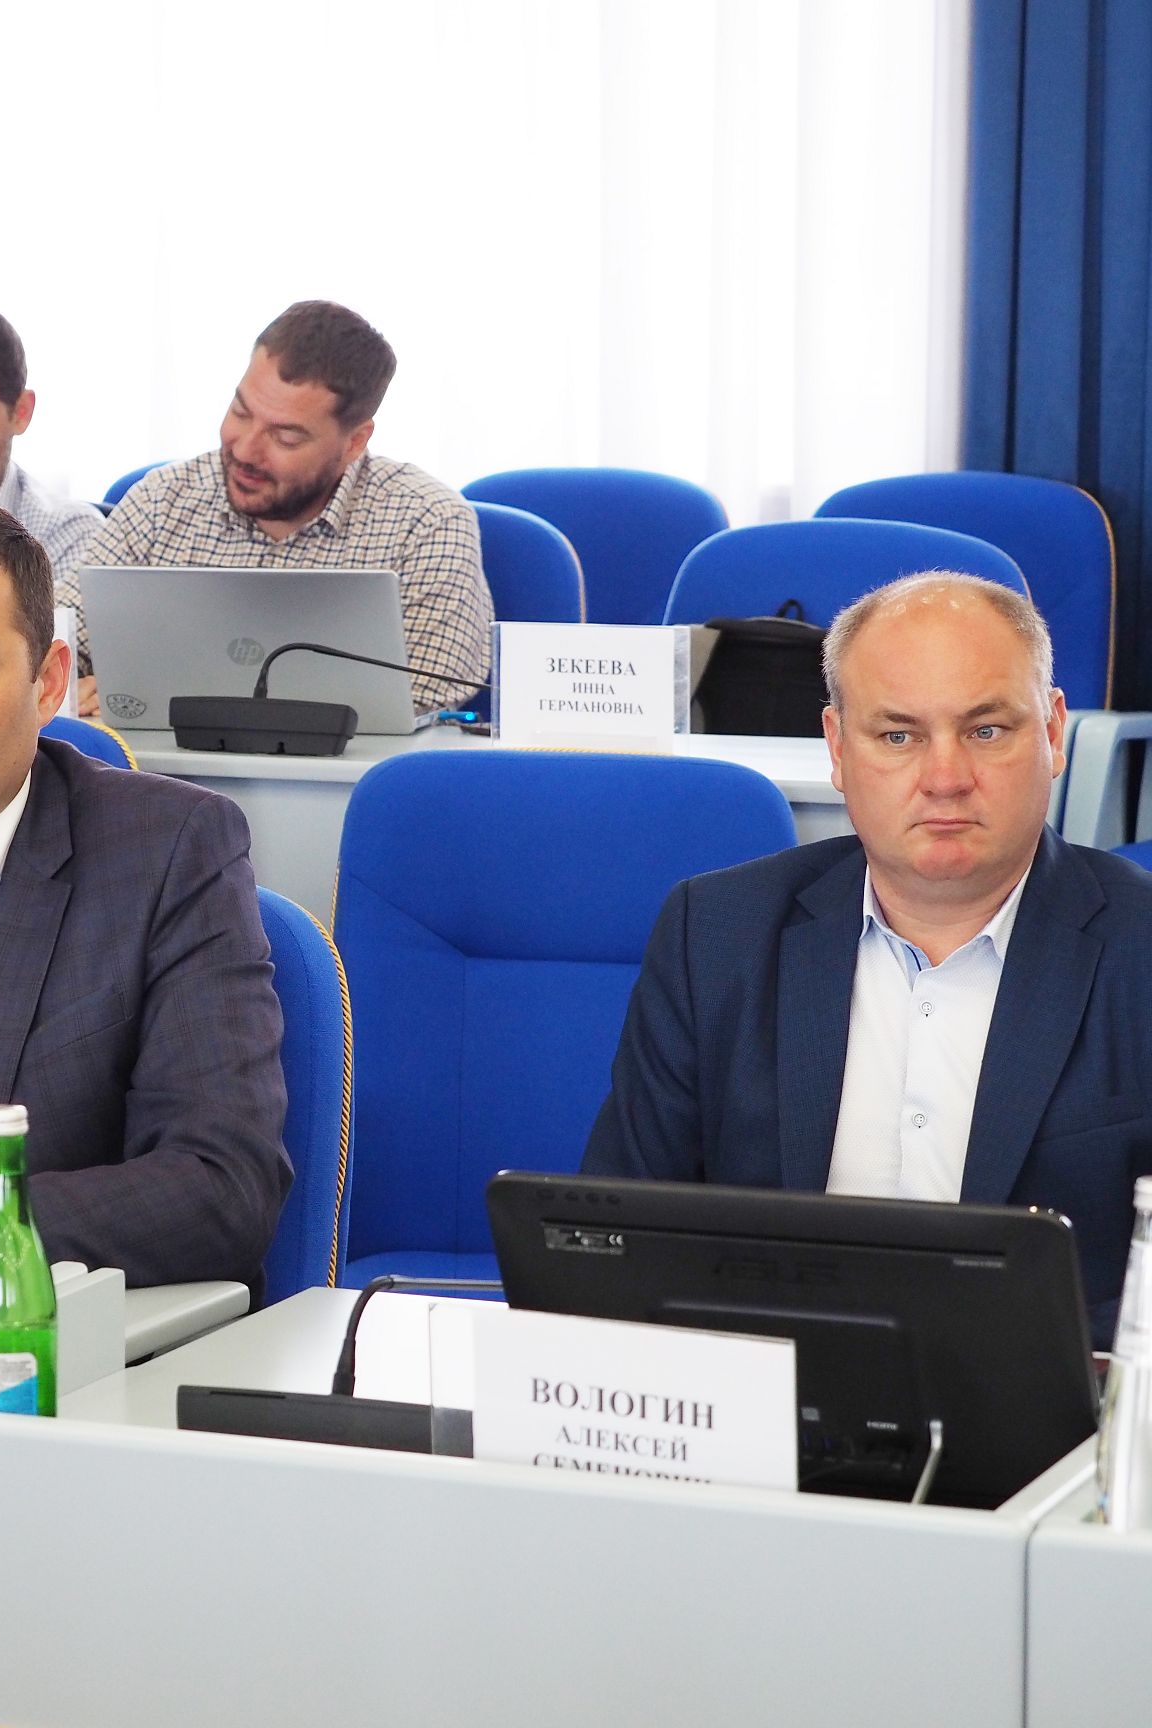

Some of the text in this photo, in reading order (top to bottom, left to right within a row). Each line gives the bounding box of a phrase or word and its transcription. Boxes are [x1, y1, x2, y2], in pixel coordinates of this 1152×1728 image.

[546, 657, 637, 677] ЗЕКЕЕВА
[572, 682, 616, 695] ИННА
[539, 699, 644, 715] ГЕРМАНОВНА
[530, 1377, 714, 1430] ВОЛОГИН
[556, 1425, 688, 1461] АЛЕКСЕЙ
